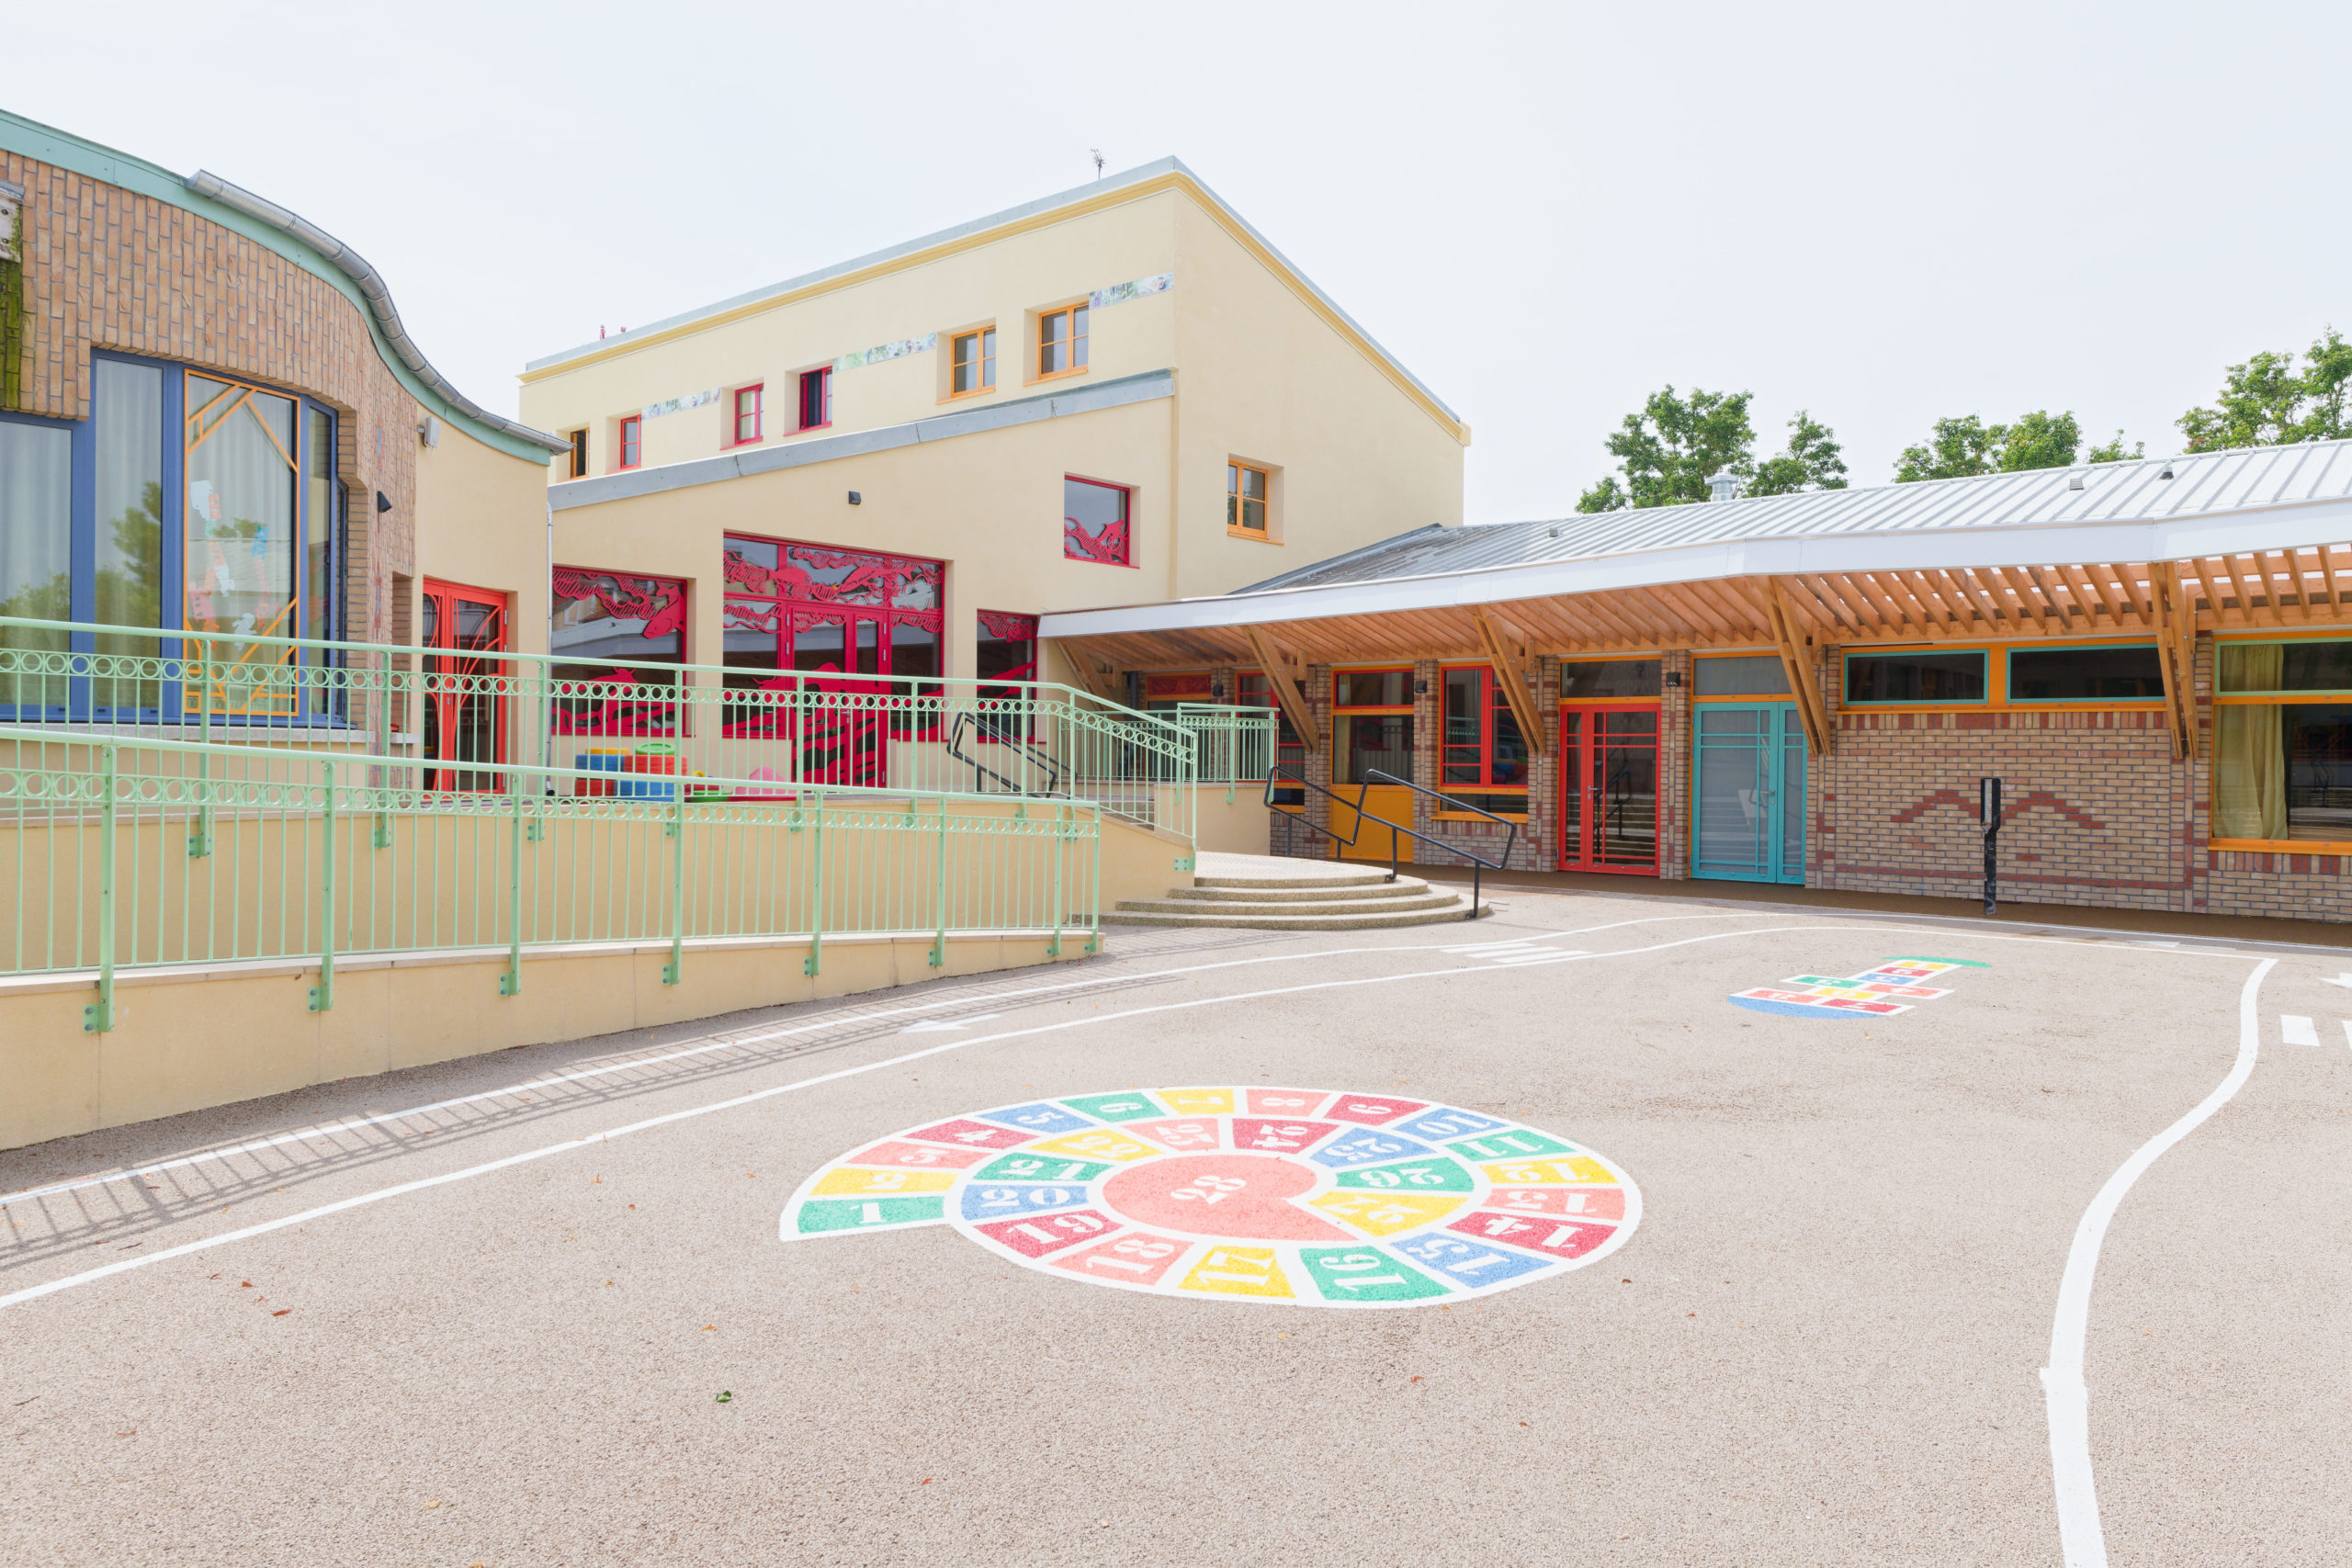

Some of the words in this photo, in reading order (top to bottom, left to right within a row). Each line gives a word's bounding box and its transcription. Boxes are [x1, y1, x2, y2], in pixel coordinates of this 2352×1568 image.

[1099, 1102, 1142, 1114] 6
[1178, 1096, 1224, 1105] 7
[1260, 1097, 1306, 1108] 8
[1347, 1104, 1391, 1114] 9
[1016, 1111, 1066, 1125] 5
[1416, 1114, 1494, 1134] 10
[953, 1129, 998, 1143] 4
[1154, 1122, 1216, 1146] 23
[1251, 1124, 1308, 1148] 24
[898, 1148, 950, 1164] 3
[1061, 1135, 1143, 1158] 22
[1324, 1137, 1403, 1160] 25
[1458, 1135, 1545, 1156] 11
[1000, 1159, 1086, 1179] 21
[1359, 1168, 1444, 1187] 26
[1498, 1162, 1589, 1181] 12
[866, 1174, 906, 1190] 2
[1170, 1175, 1248, 1205] 28
[979, 1188, 1070, 1208] 20
[1504, 1190, 1597, 1213] 13
[849, 1201, 886, 1224] 1
[1321, 1196, 1423, 1223] 27
[1007, 1214, 1103, 1244] 19
[1484, 1216, 1584, 1247] 14
[1084, 1239, 1175, 1275] 18
[1406, 1239, 1510, 1275] 15
[1197, 1252, 1275, 1286] 17
[1319, 1254, 1408, 1291] 16
